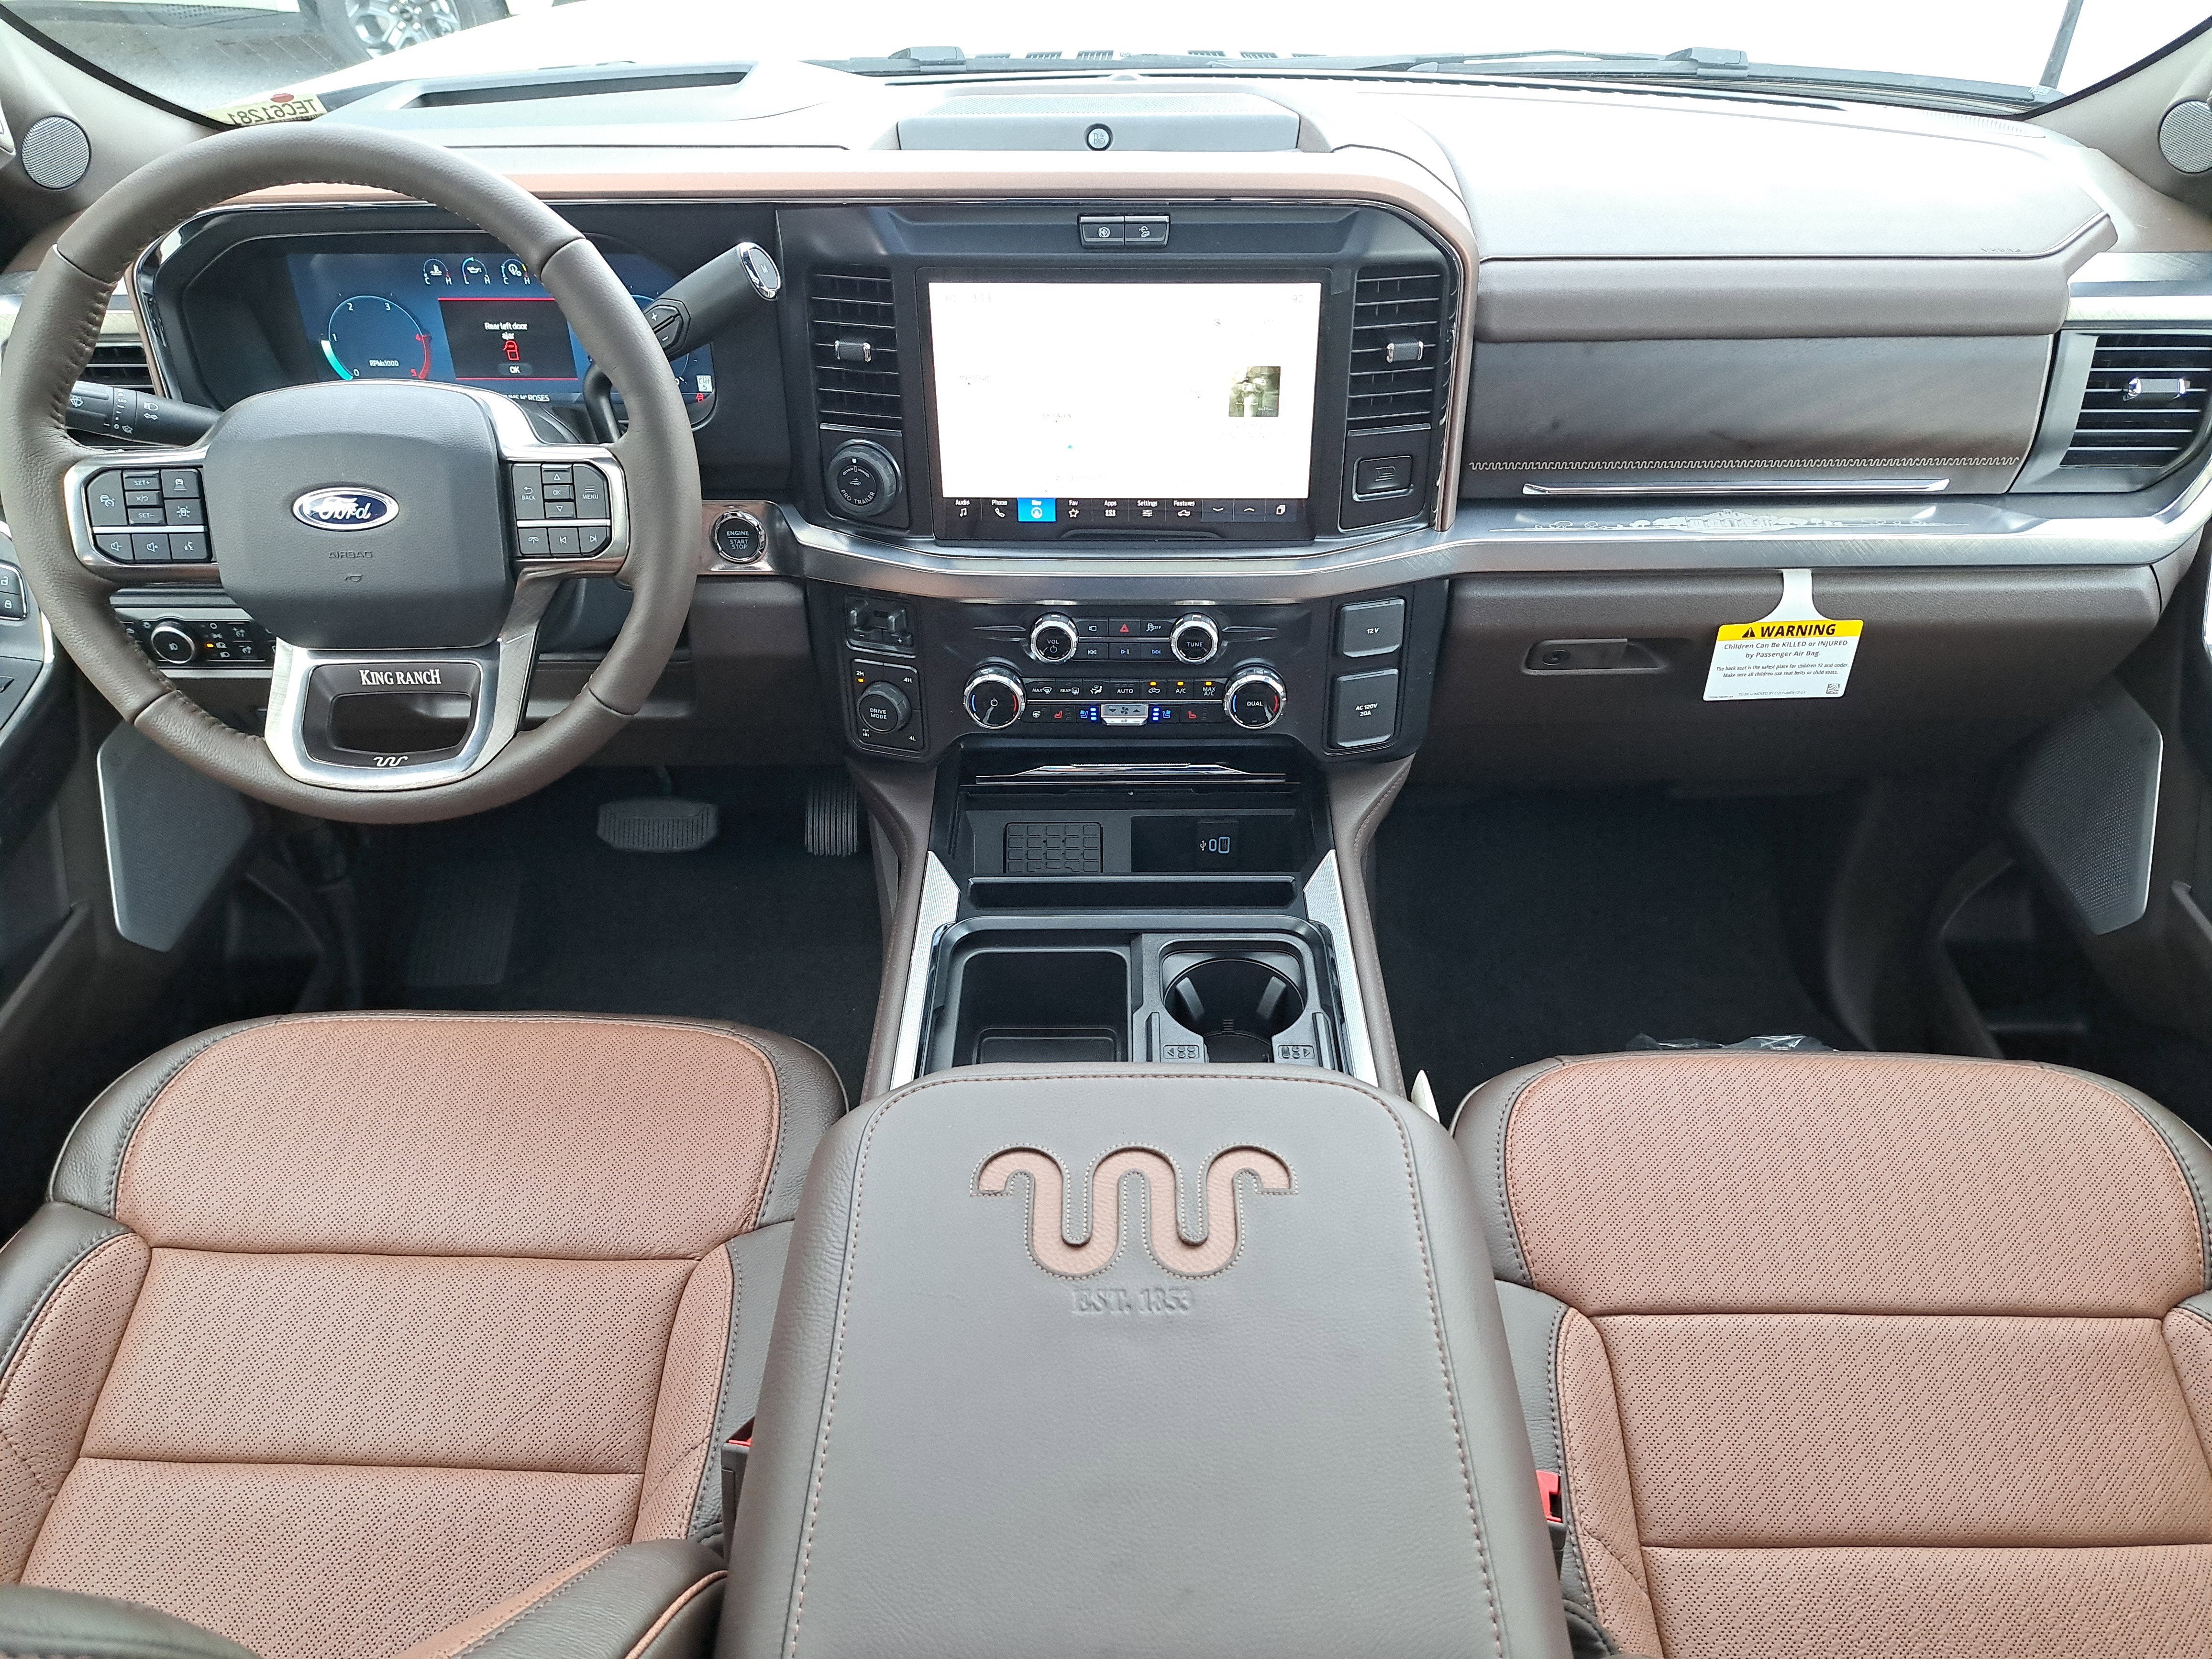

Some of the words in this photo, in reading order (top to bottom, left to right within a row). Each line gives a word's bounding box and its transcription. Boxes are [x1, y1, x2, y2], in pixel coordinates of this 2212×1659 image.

[347, 303, 354, 311] 2
[385, 302, 391, 310] 3
[484, 322, 499, 330] Rear
[500, 322, 512, 330] left
[512, 322, 528, 330] door
[502, 332, 514, 340] ajar
[411, 369, 417, 377] 5
[841, 489, 852, 501] PRO
[854, 491, 875, 505] TRAILER
[312, 496, 372, 520] Ford
[1137, 499, 1158, 508] Settings
[1761, 624, 1836, 637] WARNING
[359, 669, 394, 686] KING
[395, 669, 442, 685] RANCH
[1072, 1288, 1132, 1314] EST.
